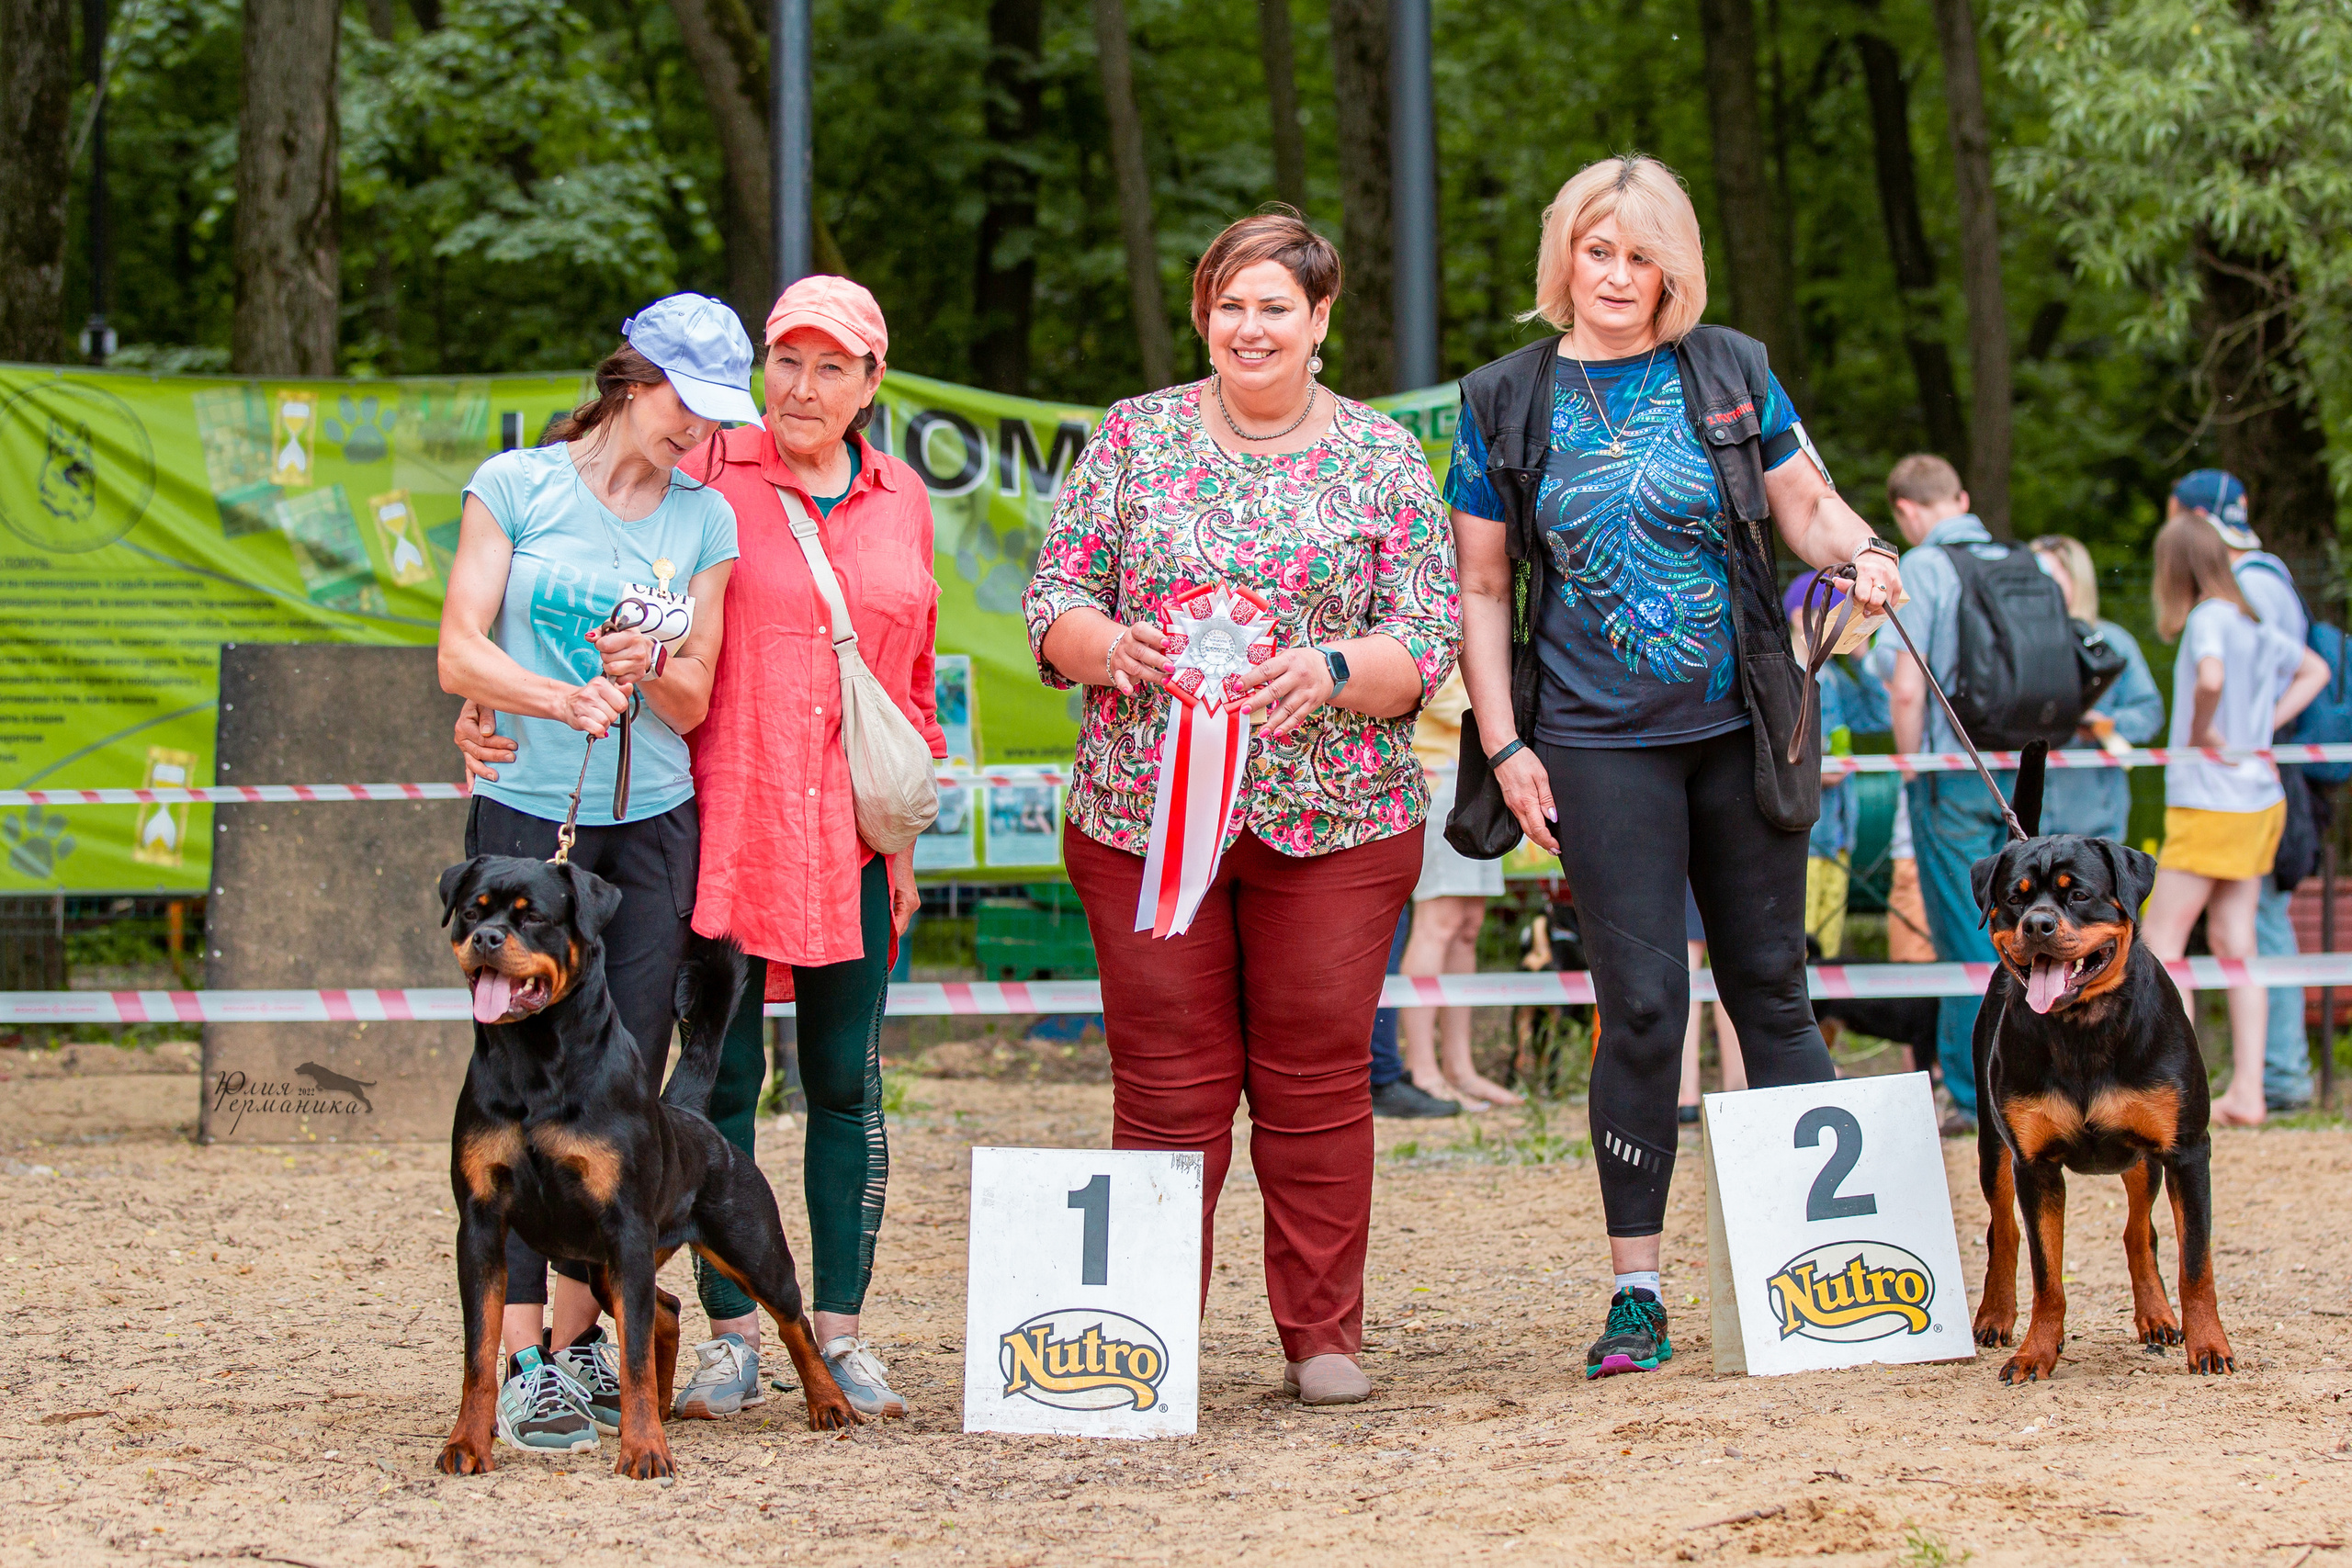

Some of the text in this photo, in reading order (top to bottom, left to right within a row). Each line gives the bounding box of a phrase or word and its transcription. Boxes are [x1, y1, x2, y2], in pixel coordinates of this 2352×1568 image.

[543, 558, 627, 617] RU
[1793, 1105, 1878, 1222] 2
[1067, 1174, 1112, 1286] 1
[1766, 1252, 1931, 1341] Nutro
[1000, 1322, 1162, 1412] Nutro
